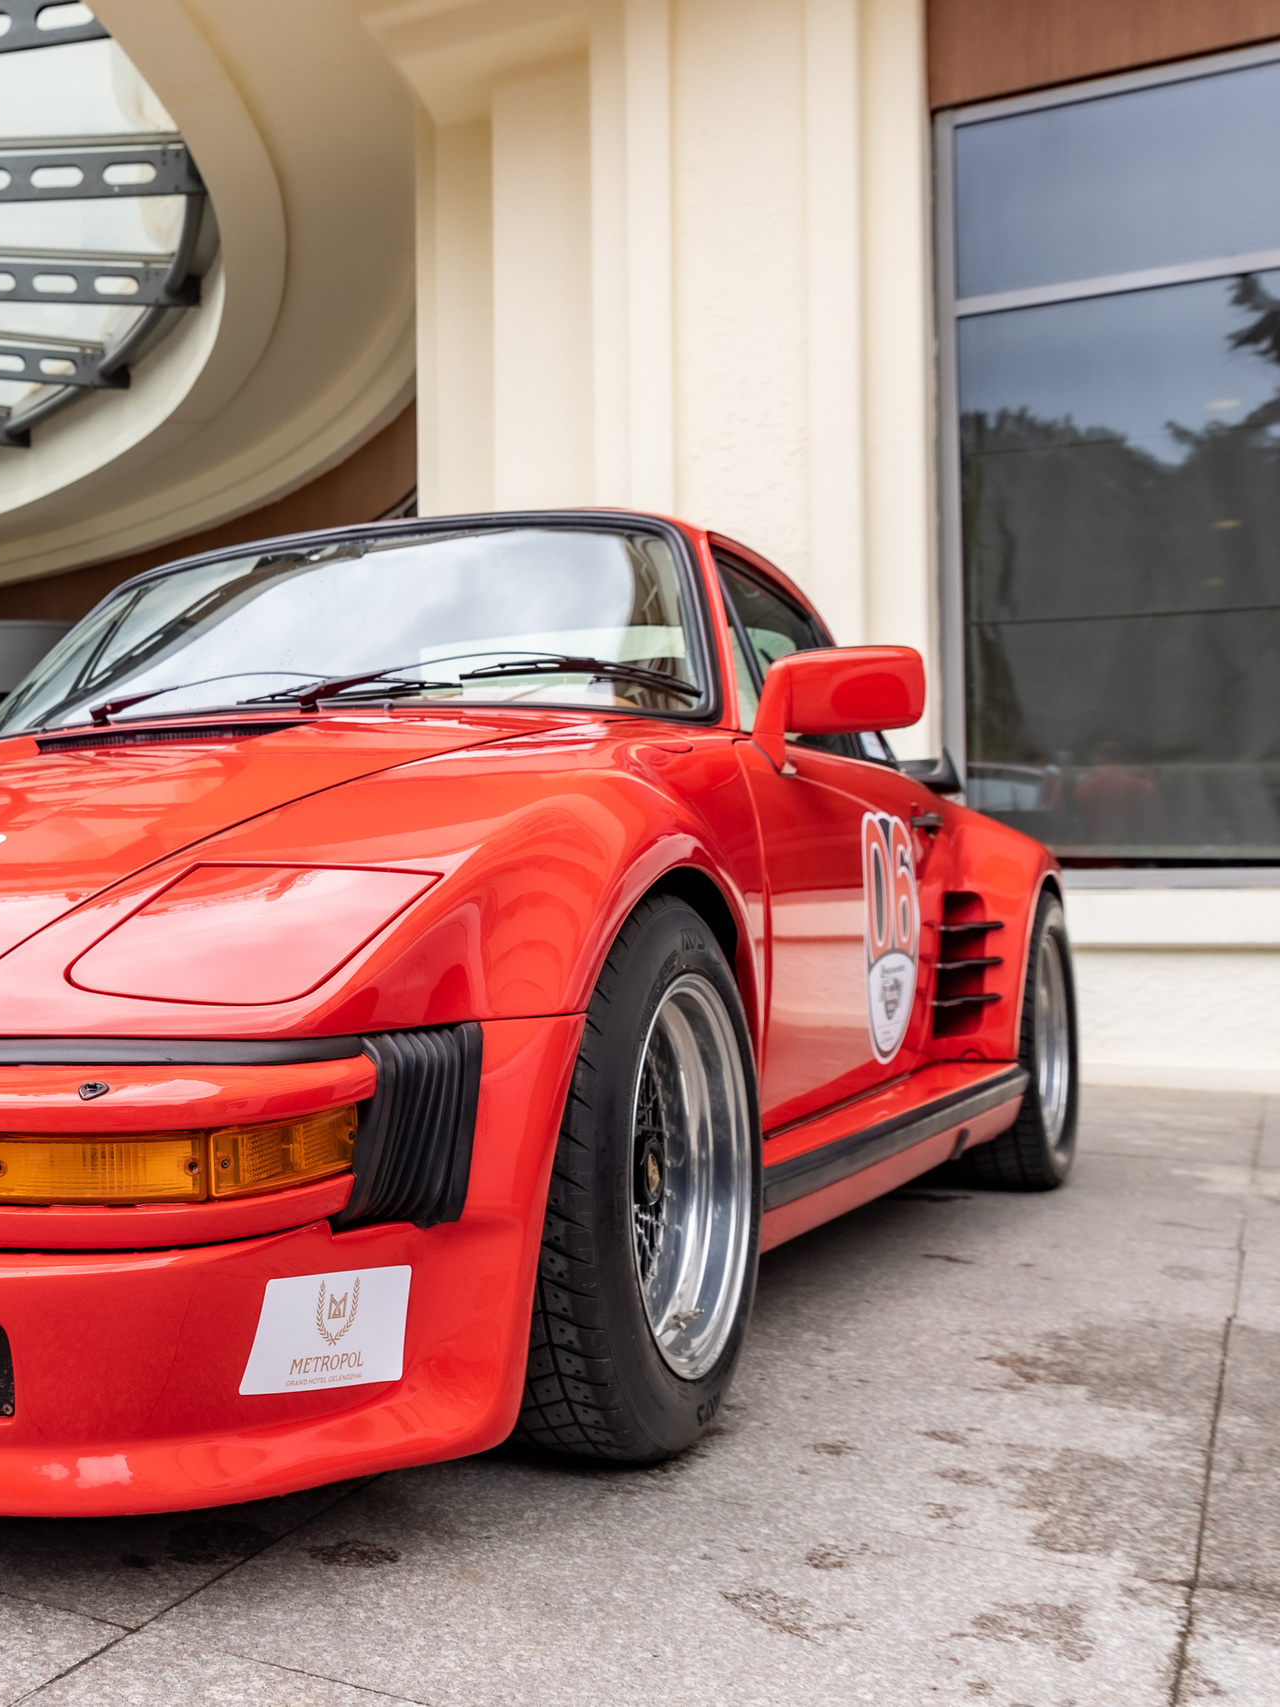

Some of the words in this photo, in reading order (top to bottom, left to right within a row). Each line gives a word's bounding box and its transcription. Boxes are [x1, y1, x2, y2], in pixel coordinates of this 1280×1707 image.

[864, 815, 917, 962] 06
[289, 1351, 364, 1375] METROPOL
[285, 1378, 308, 1387] GRAND
[308, 1376, 327, 1385] HOTEL
